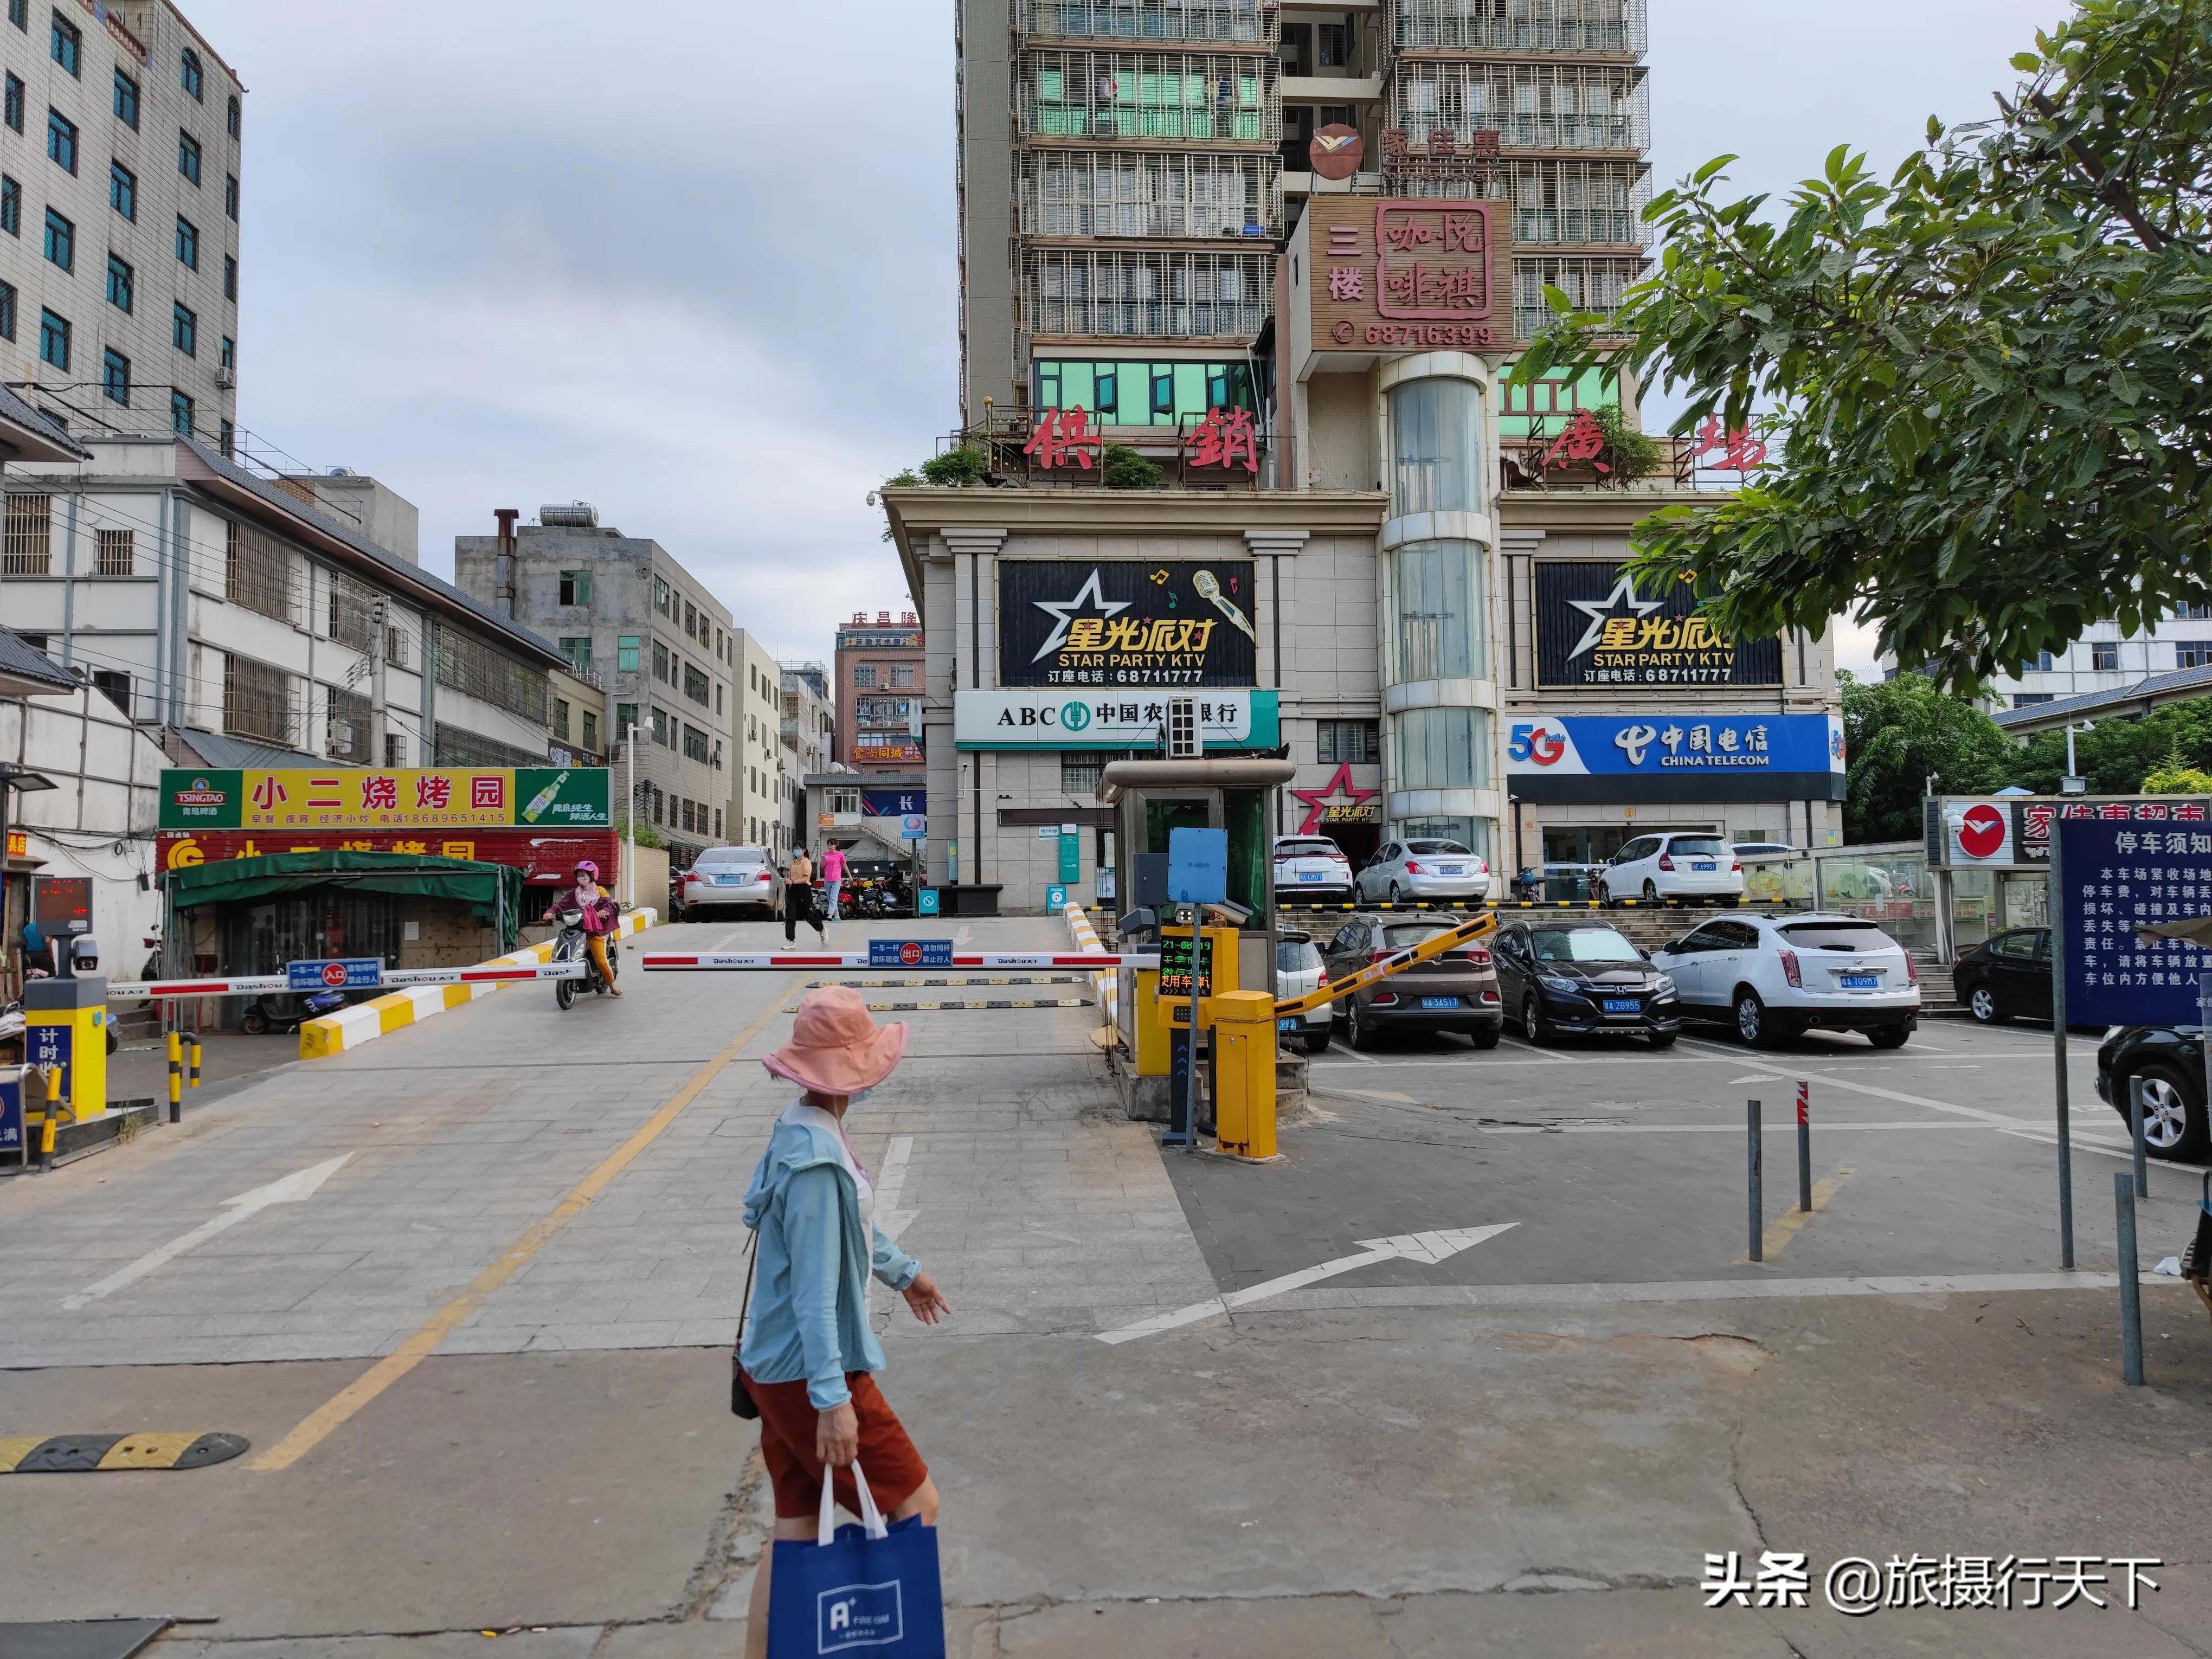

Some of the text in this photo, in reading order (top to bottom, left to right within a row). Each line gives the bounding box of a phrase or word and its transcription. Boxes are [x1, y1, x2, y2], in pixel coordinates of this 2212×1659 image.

[1383, 127, 1501, 157] 家佳惠
[1327, 226, 1364, 301] 三楼
[1366, 325, 1492, 345] 68716399
[1060, 615, 1218, 652] 星光派对
[1594, 616, 1735, 651] 星光派
[1059, 654, 1206, 667] STAR PARTY KTV
[1593, 652, 1735, 666] STAR PARTY KTV
[997, 707, 1056, 725] ABC
[1096, 703, 1238, 723] 中国农银行
[1508, 724, 1565, 766] 5G
[1661, 724, 1769, 754] 中国电信
[1661, 755, 1769, 766] CHINA TELECOM
[177, 794, 224, 803] TSINGTAO
[252, 775, 505, 811] 小二烧烤园
[252, 814, 275, 824] 早餐
[286, 814, 309, 824] 夜宵
[319, 814, 369, 824] 经济小炒
[1326, 806, 1376, 818] 星光派对
[2114, 831, 2212, 854] 停车须知
[871, 944, 900, 952] 一车一杆
[902, 949, 920, 958] 出口
[871, 955, 951, 963] 损坏赔偿 禁止行人
[2085, 972, 2198, 986] 车位内方便他人
